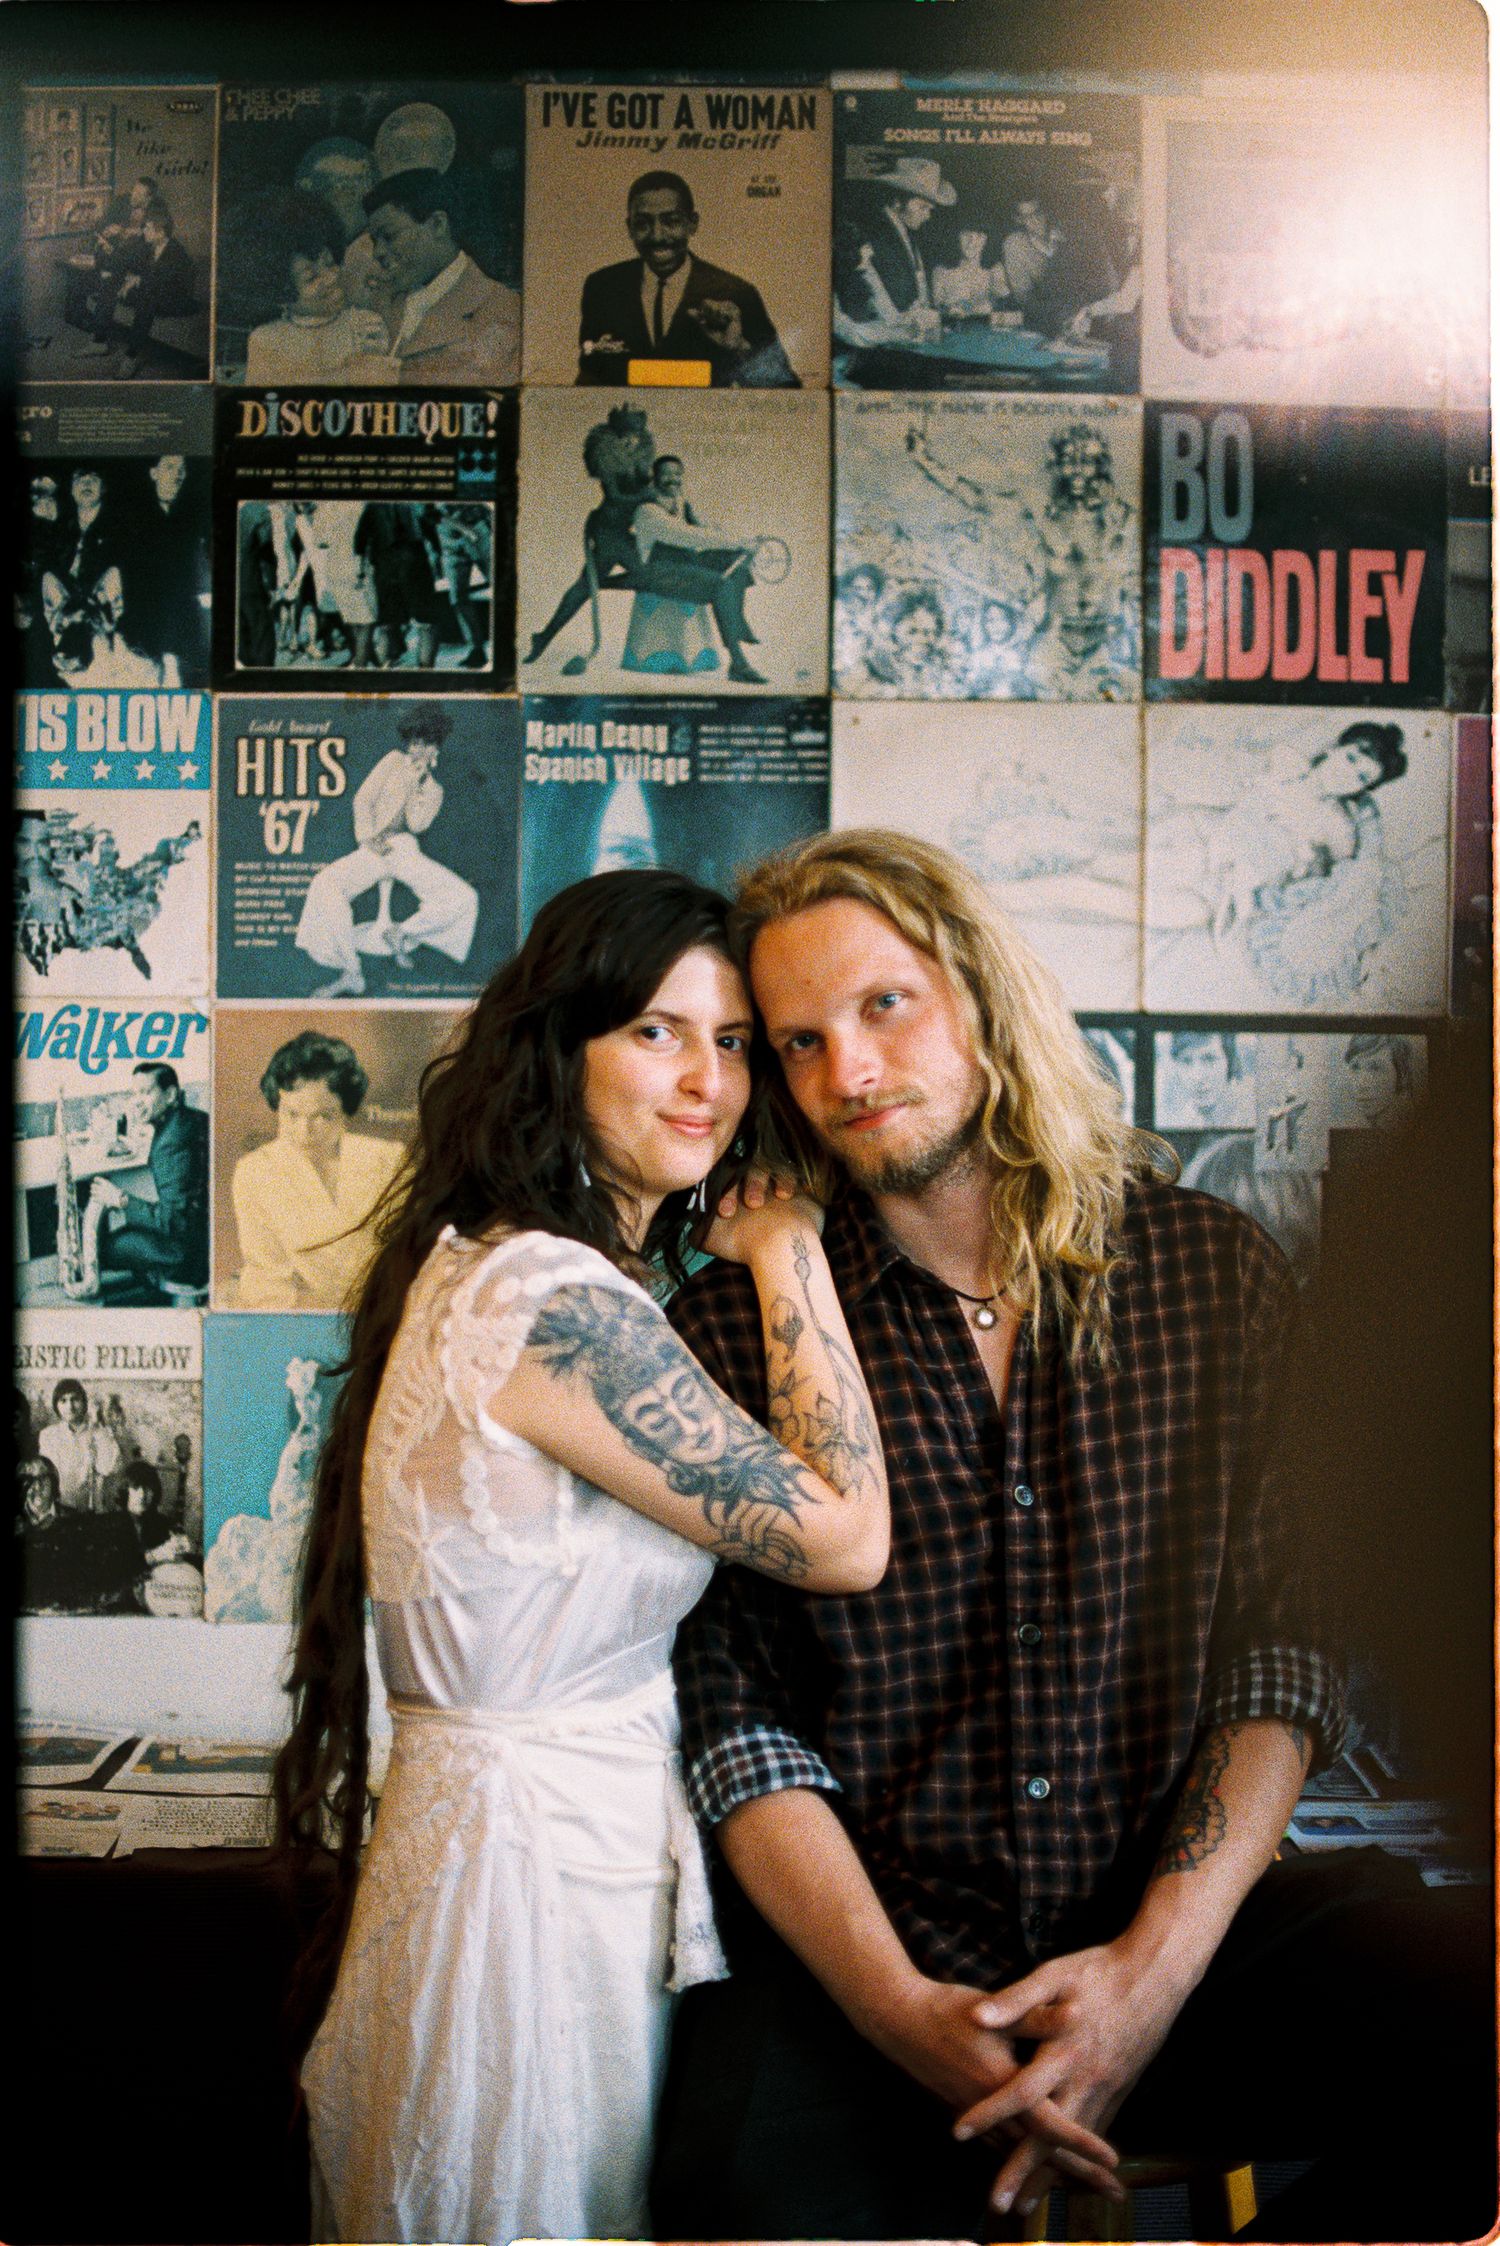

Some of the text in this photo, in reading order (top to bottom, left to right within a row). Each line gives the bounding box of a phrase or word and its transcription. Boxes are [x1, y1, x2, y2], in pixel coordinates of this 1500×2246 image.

[243, 105, 298, 121] PEPPY
[542, 91, 818, 132] I'VE GOT A WOMAN
[916, 98, 1067, 115] MERLE HAGGARD
[575, 131, 783, 152] Jimmy McGriff
[883, 128, 1093, 147] SONGS I'LL ALWAYS SING
[1159, 411, 1254, 544] BO
[1159, 548, 1427, 684] DIDDLEY
[76, 694, 202, 752] BLOW
[526, 720, 668, 753] Martin Denny
[237, 738, 346, 797] HITS
[525, 753, 690, 785] Spanish Village
[15, 1003, 208, 1075] Walker
[95, 1345, 192, 1370] PILLOW
